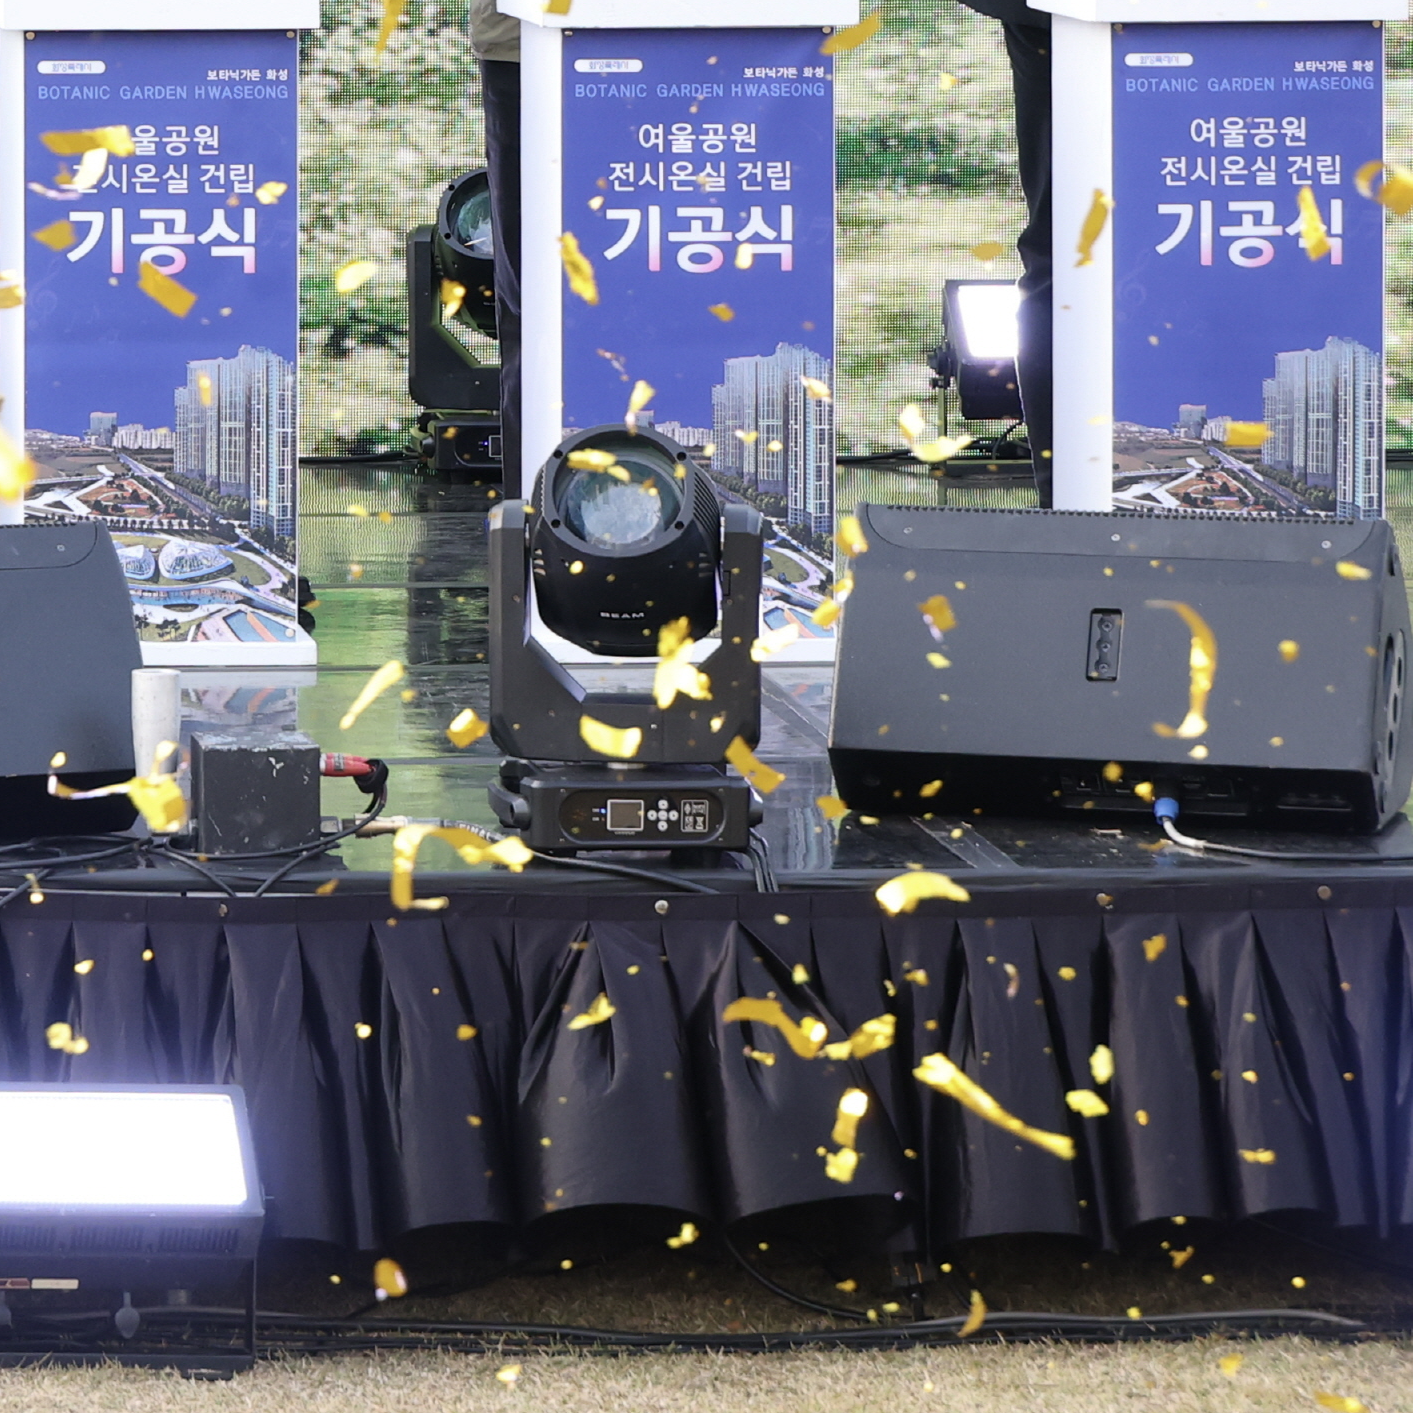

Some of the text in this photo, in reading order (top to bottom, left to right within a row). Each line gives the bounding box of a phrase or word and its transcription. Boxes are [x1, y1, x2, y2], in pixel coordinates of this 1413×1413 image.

[207, 69, 288, 81] 보타닉가든 화성
[744, 67, 824, 78] 보타닉가든 화성
[1294, 60, 1374, 72] 보타닉가든 화성
[38, 86, 288, 99] BOTANIC GARDEN HWASEONG
[576, 84, 824, 97] BOTANIC GARDEN HWASEONG
[1126, 77, 1374, 92] BOTANIC GARDEN HWASEONG
[132, 125, 219, 156] 울공원
[639, 123, 756, 153] 여울공원
[1190, 116, 1306, 147] 여울공원
[200, 164, 253, 193] 건립
[609, 161, 791, 191] 전시온실 건립
[1161, 155, 1340, 186] 전시온실 건립
[67, 208, 255, 275] 기공식
[603, 205, 793, 273] 기공식
[1155, 199, 1342, 268] 기공식
